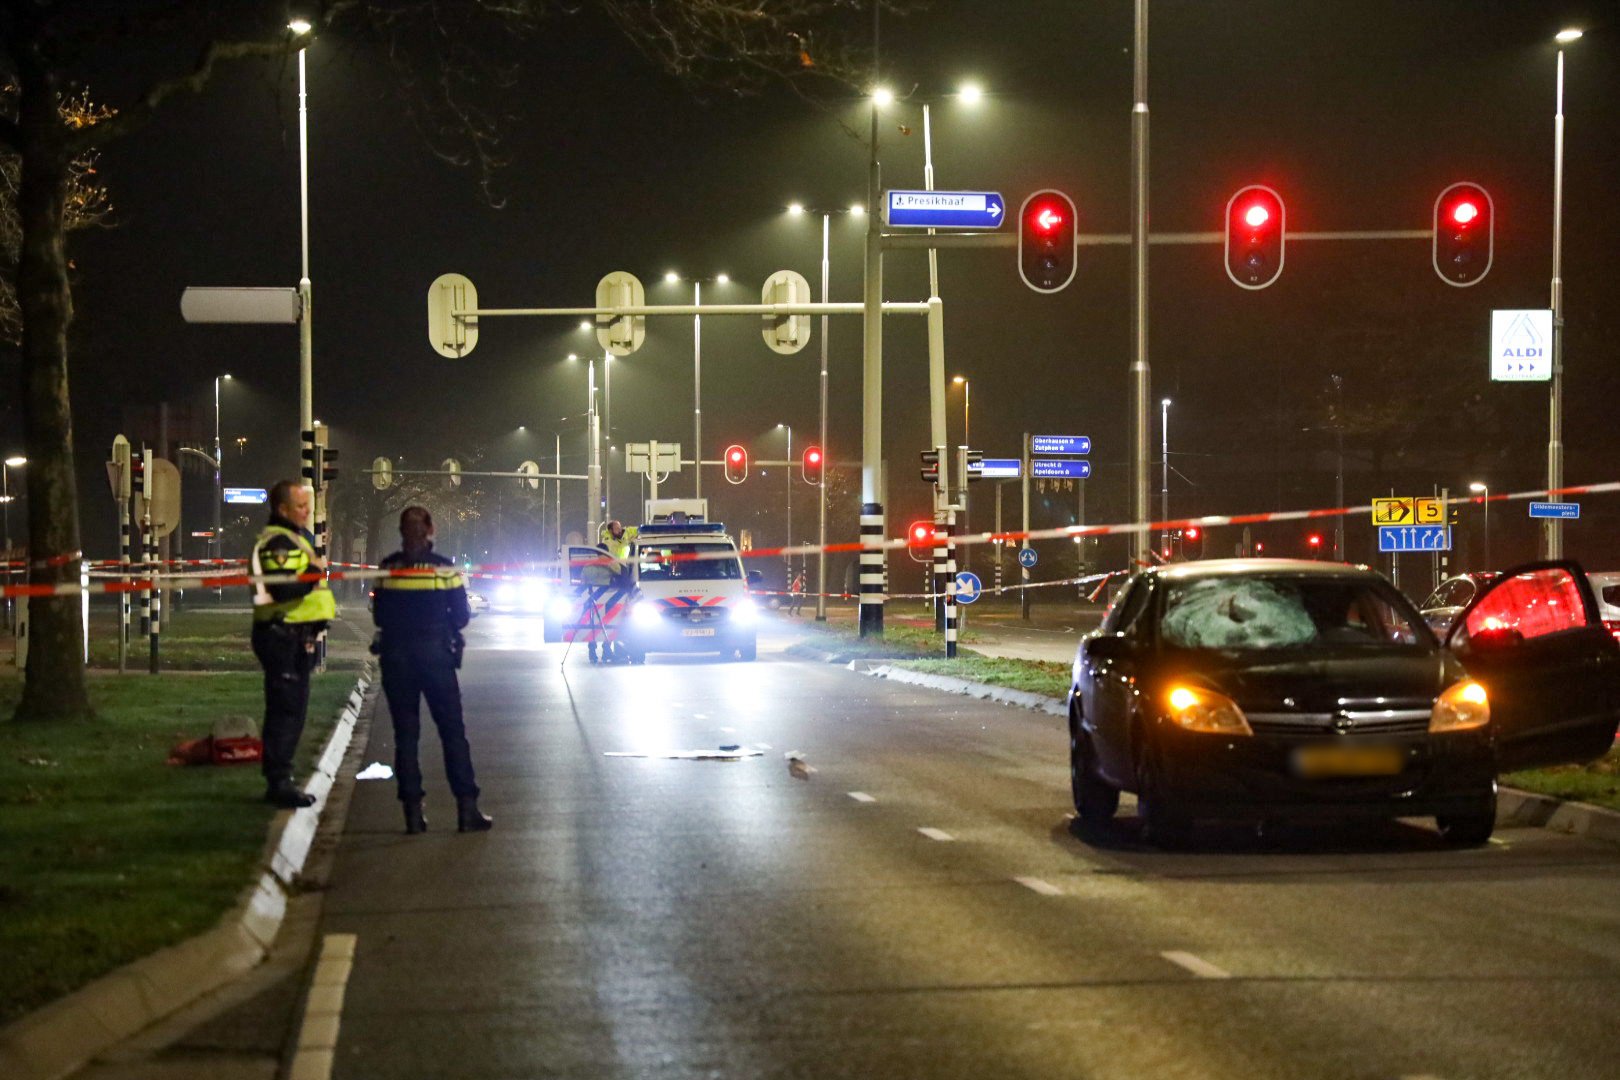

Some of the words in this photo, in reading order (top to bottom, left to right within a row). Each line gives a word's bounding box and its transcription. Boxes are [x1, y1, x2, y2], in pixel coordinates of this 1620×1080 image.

[908, 195, 965, 206] Presikhaaf
[1503, 347, 1543, 357] ALDI
[1426, 504, 1438, 517] 5
